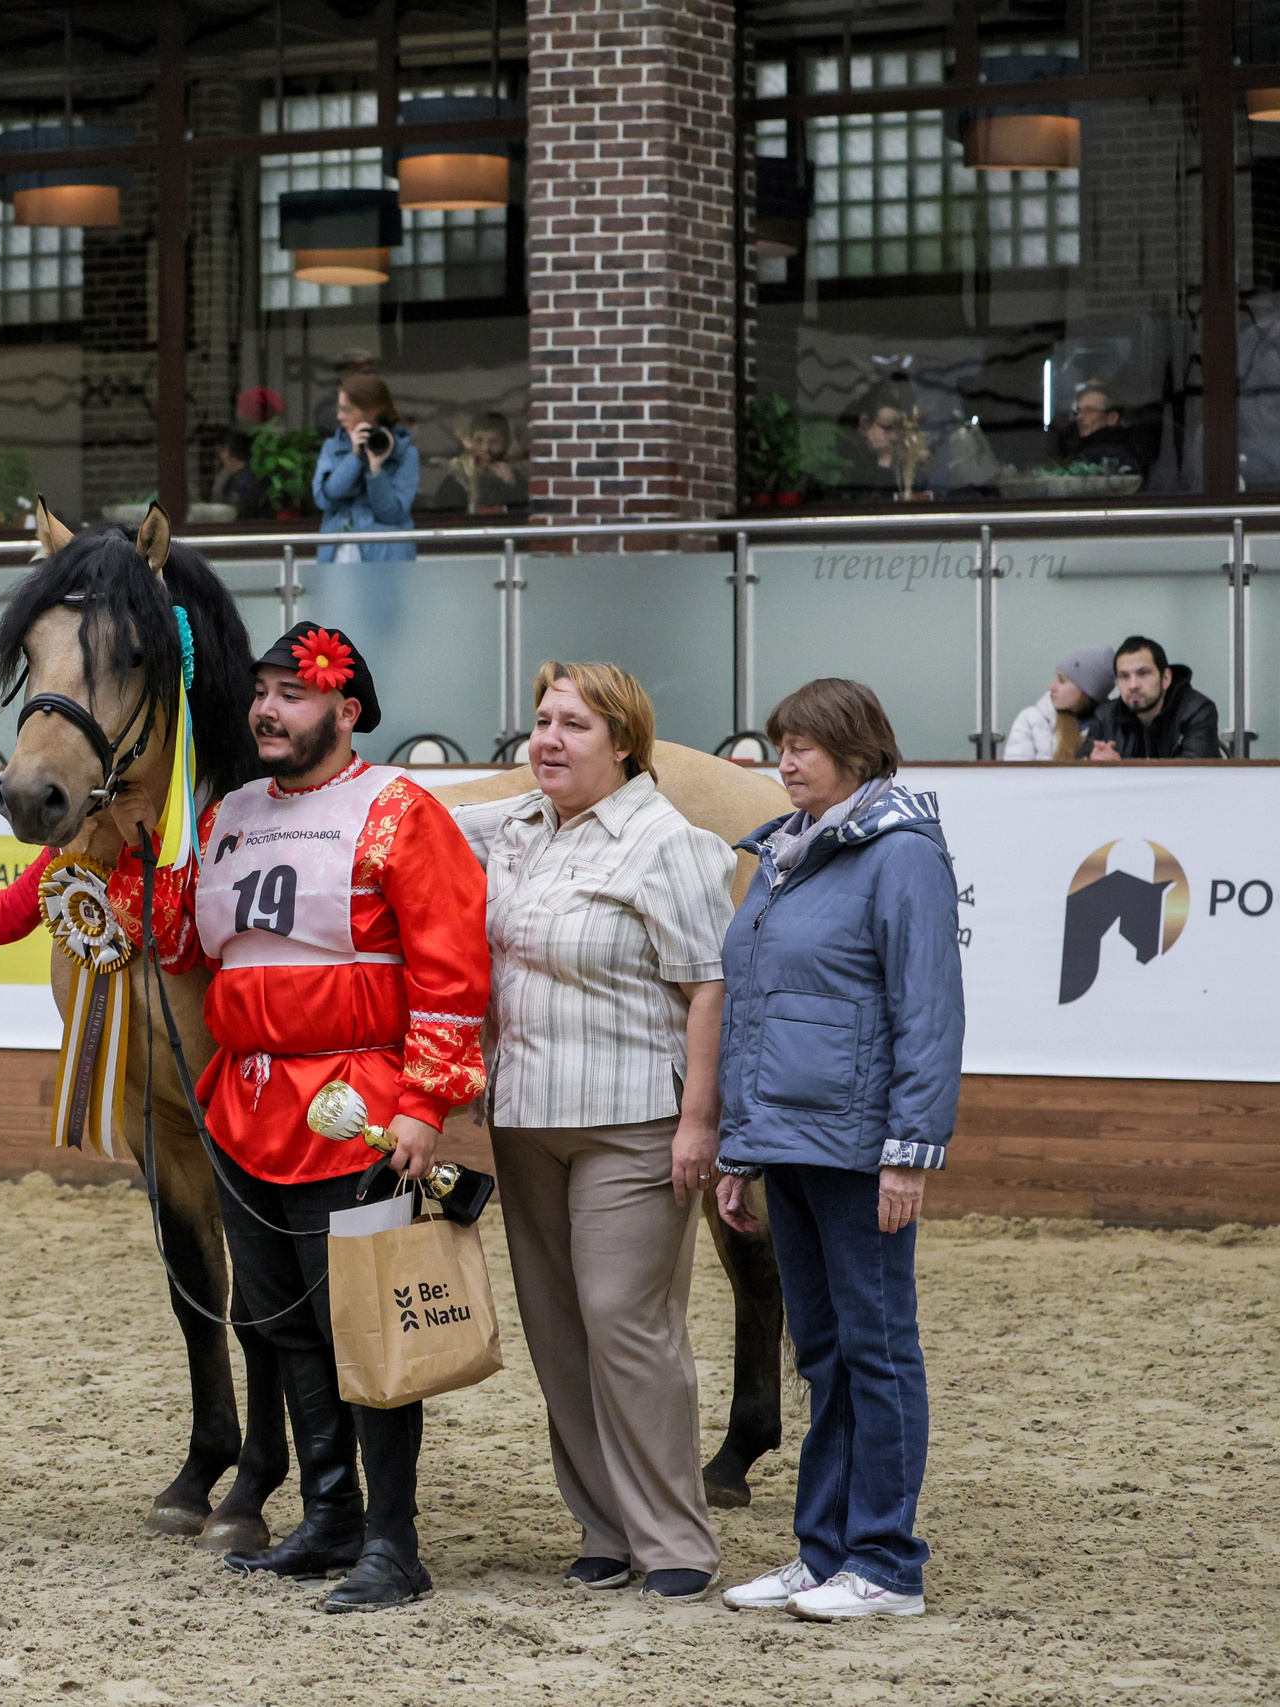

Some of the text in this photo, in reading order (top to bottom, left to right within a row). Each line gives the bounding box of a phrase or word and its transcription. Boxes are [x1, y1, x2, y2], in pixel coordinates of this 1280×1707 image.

[245, 830, 341, 846] РОСПЛЕМКОНЗАВОД
[249, 826, 282, 836] АССОЦИАЦИЯ
[232, 864, 298, 938] 19
[418, 1283, 450, 1303] Be:
[424, 1304, 472, 1328] Natu
